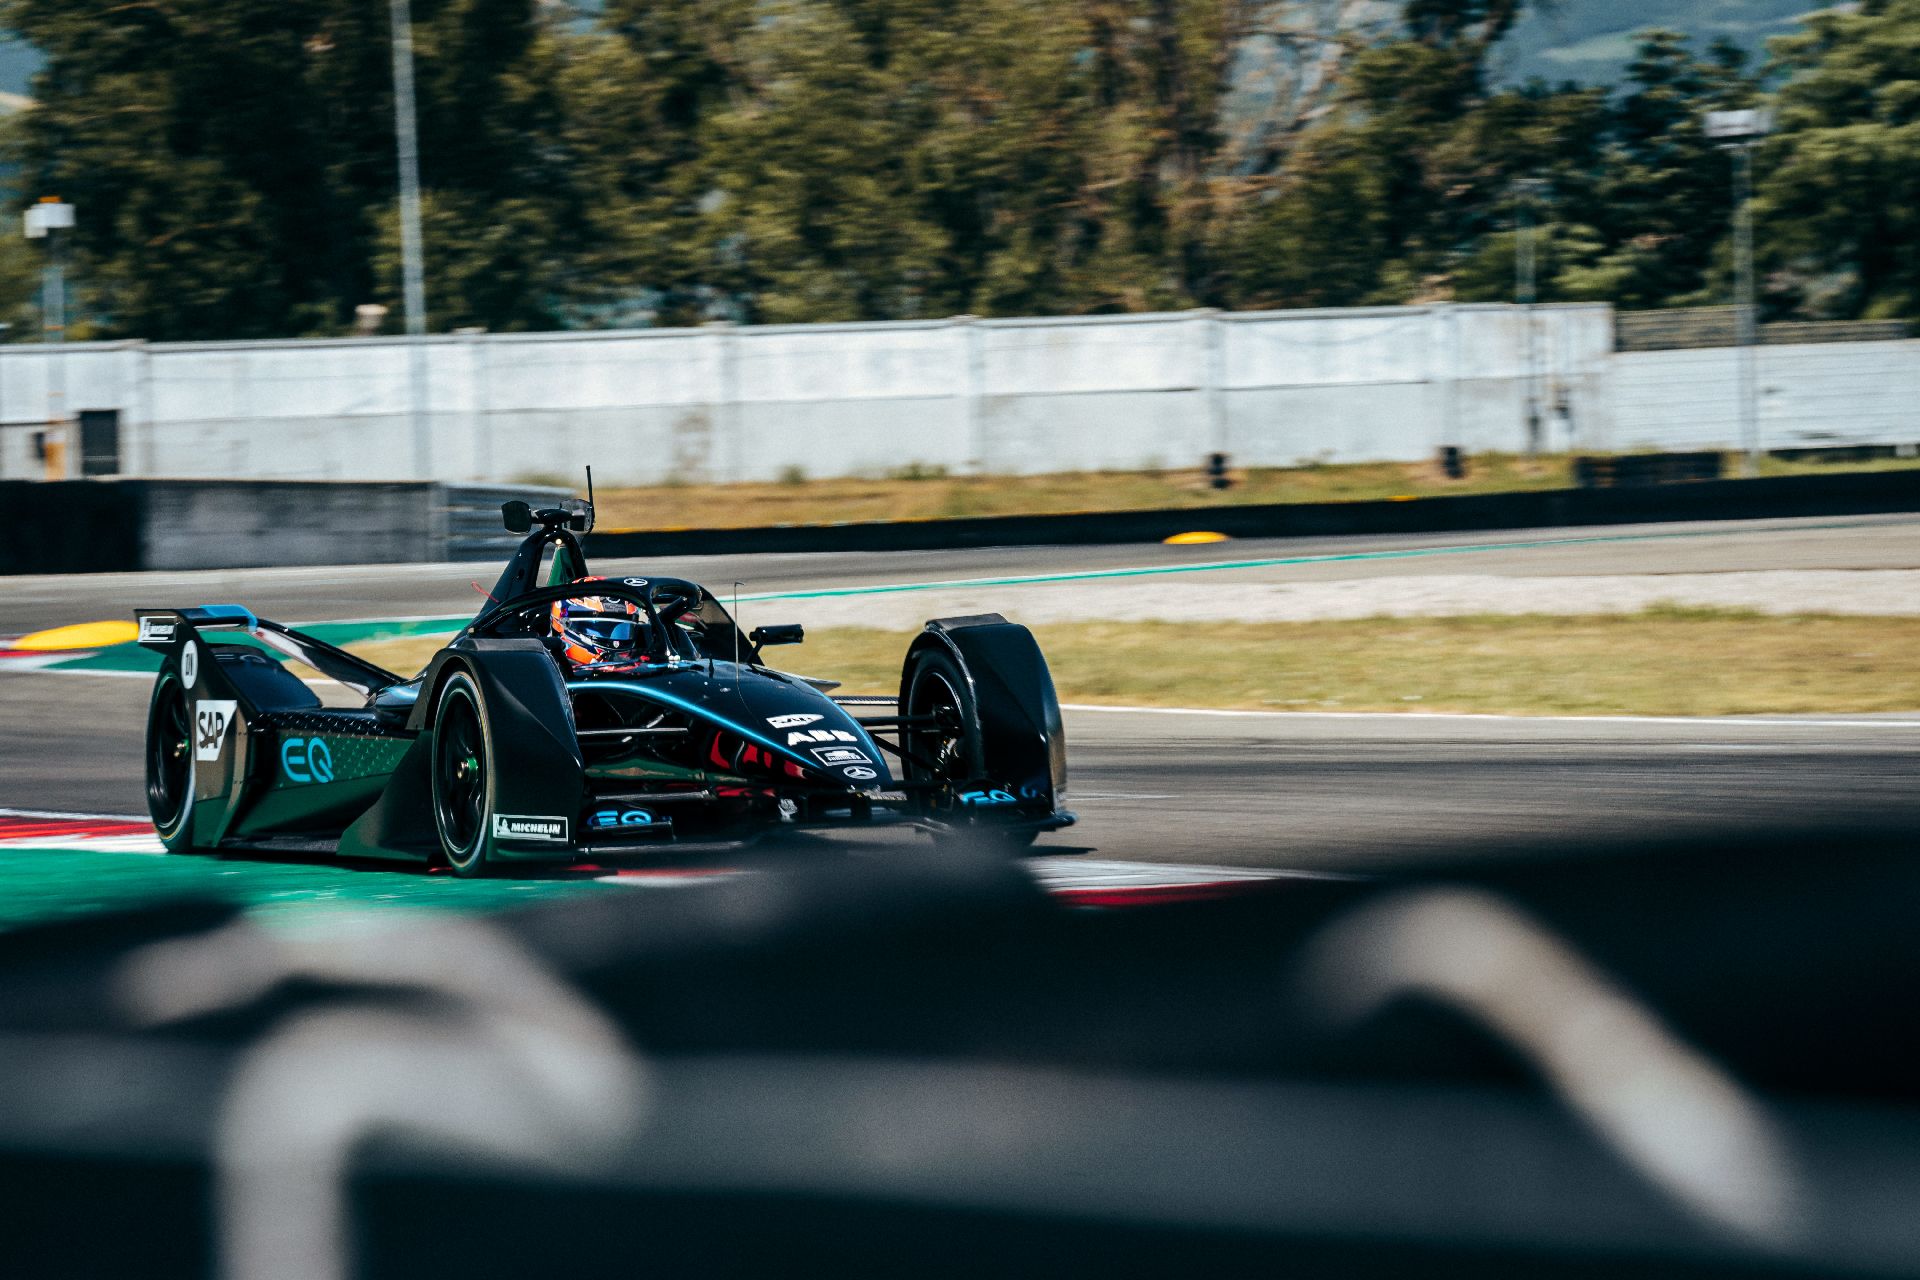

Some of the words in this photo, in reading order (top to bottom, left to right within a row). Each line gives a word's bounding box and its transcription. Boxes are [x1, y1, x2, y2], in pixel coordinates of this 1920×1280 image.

[198, 711, 224, 749] SAP
[788, 730, 857, 746] ABB
[281, 737, 334, 783] EQ
[588, 810, 651, 825] EQ
[510, 823, 561, 835] MICHELIN
